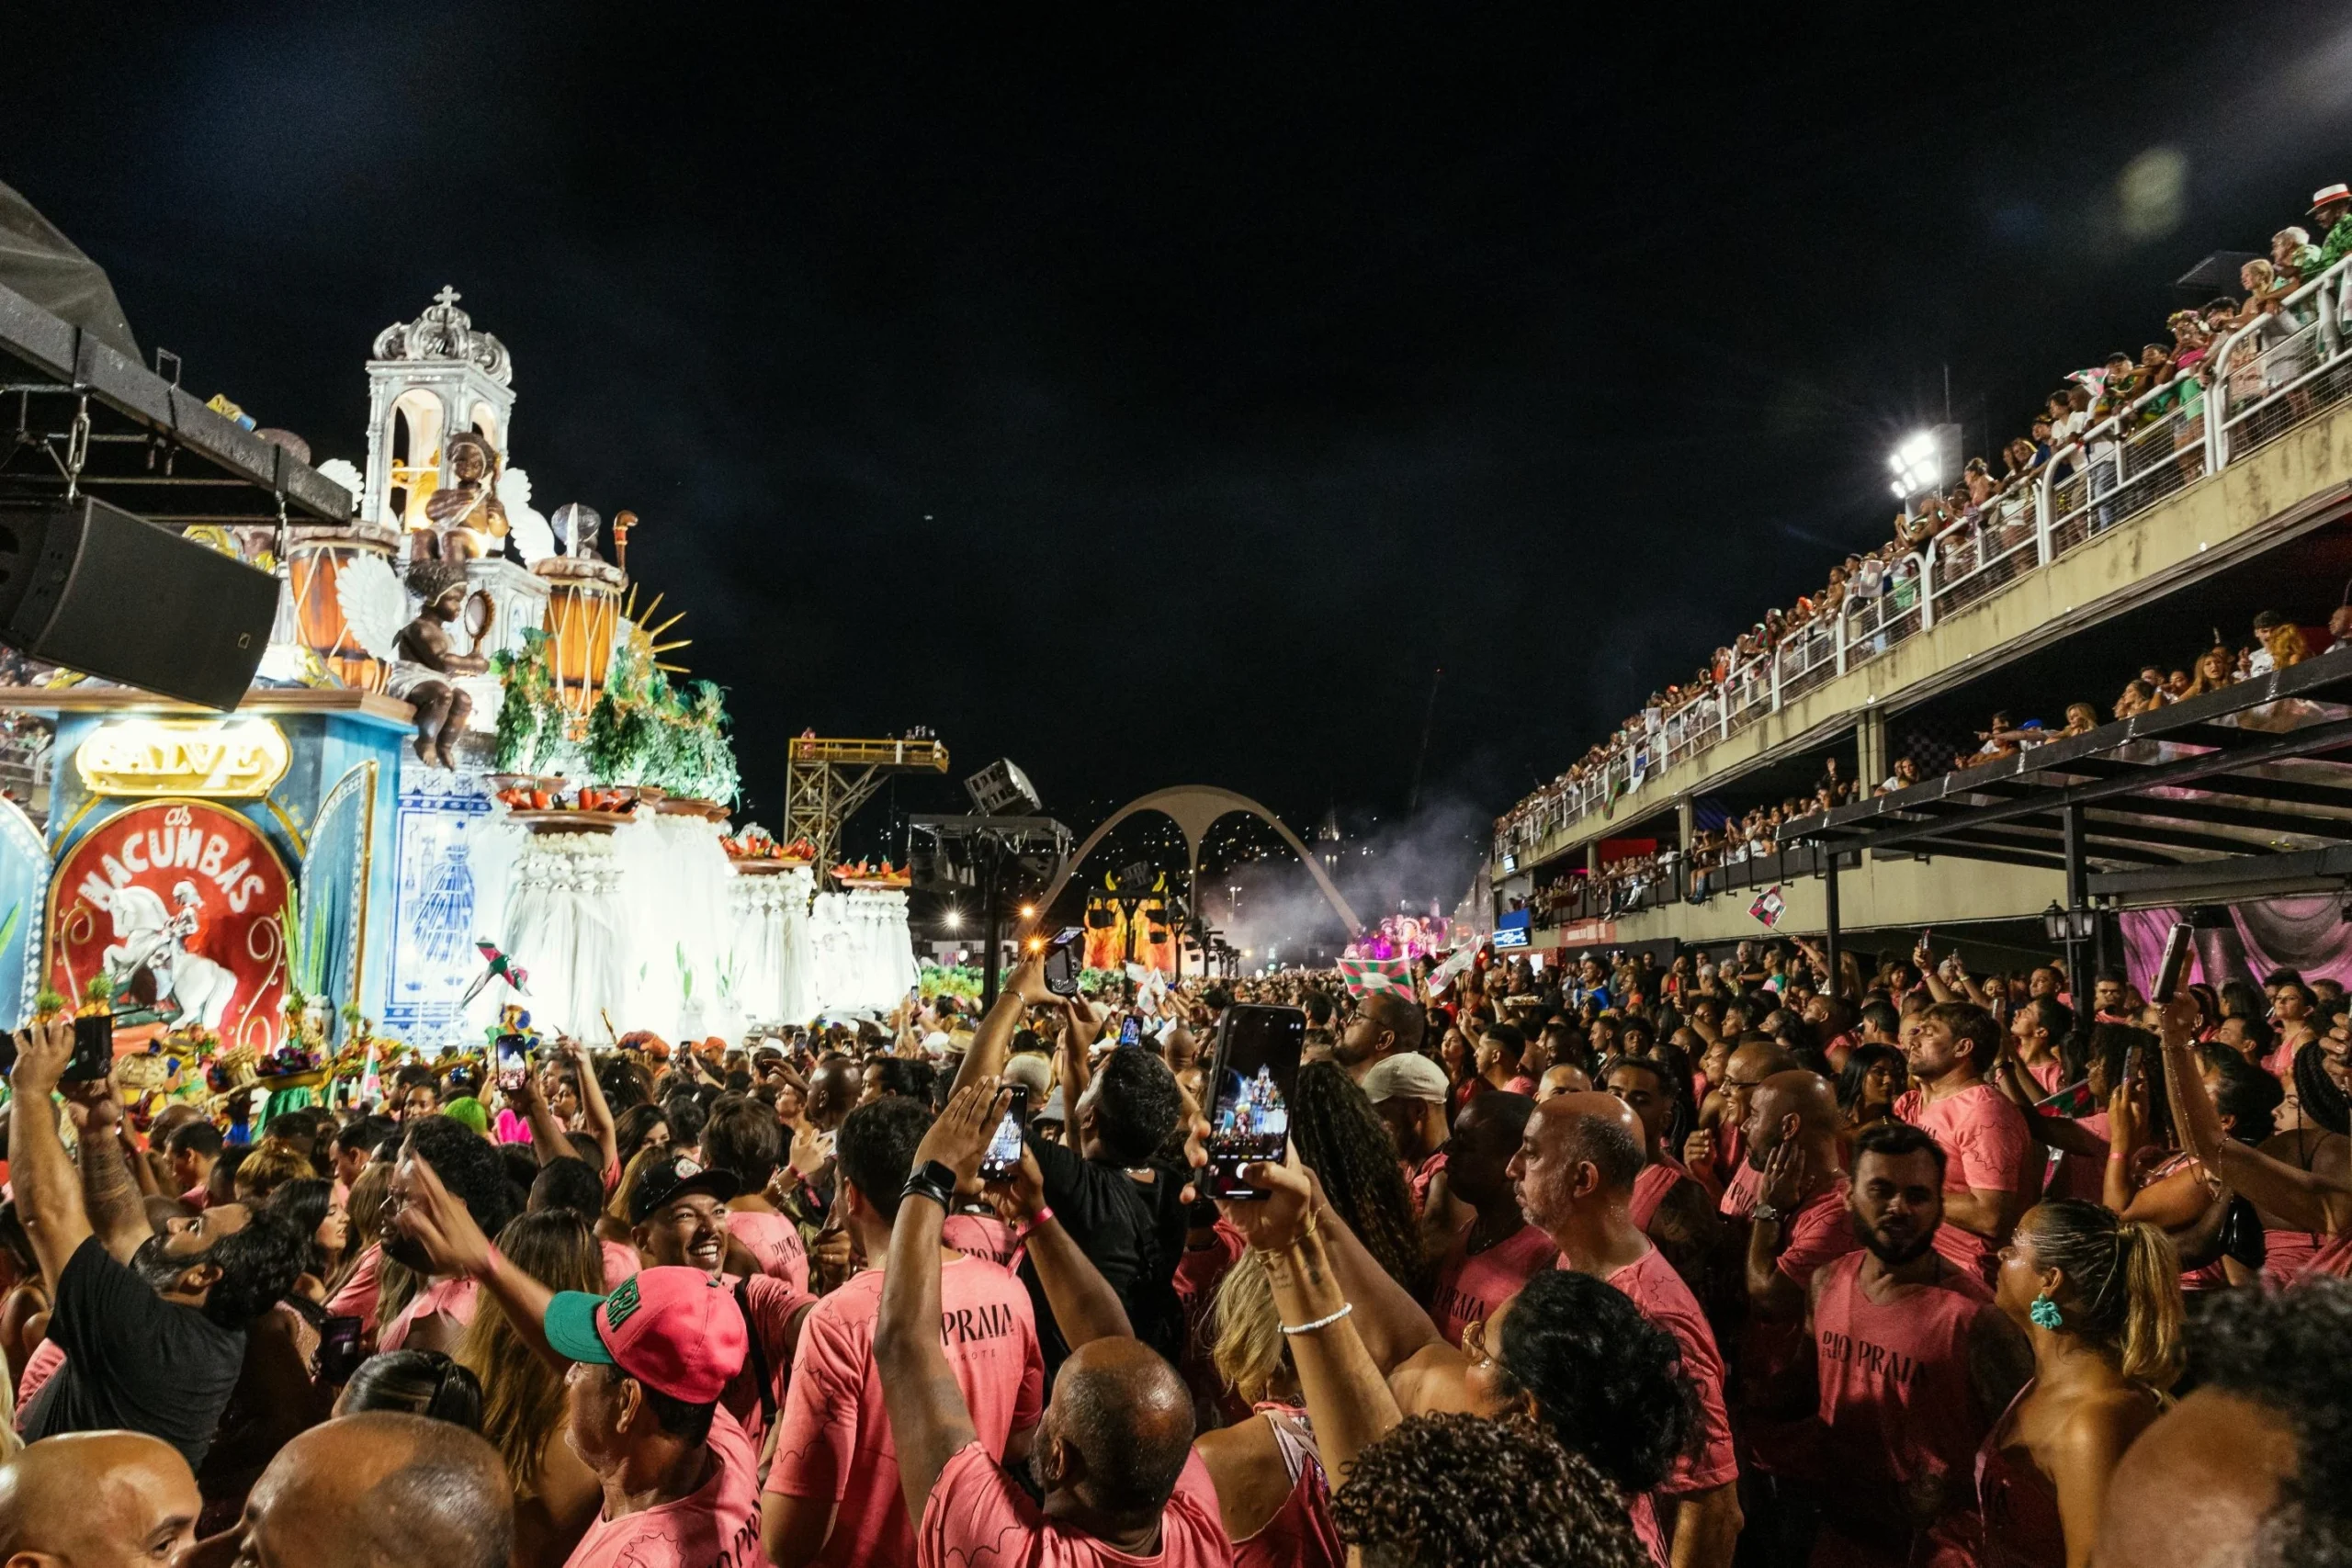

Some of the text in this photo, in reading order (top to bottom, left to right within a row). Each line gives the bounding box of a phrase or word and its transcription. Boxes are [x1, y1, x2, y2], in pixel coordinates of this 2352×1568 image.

[164, 806, 192, 827] as
[77, 827, 265, 913] MACUMBAS
[941, 1303, 1014, 1347] PRAIA
[1857, 1340, 1928, 1386] PRAIA
